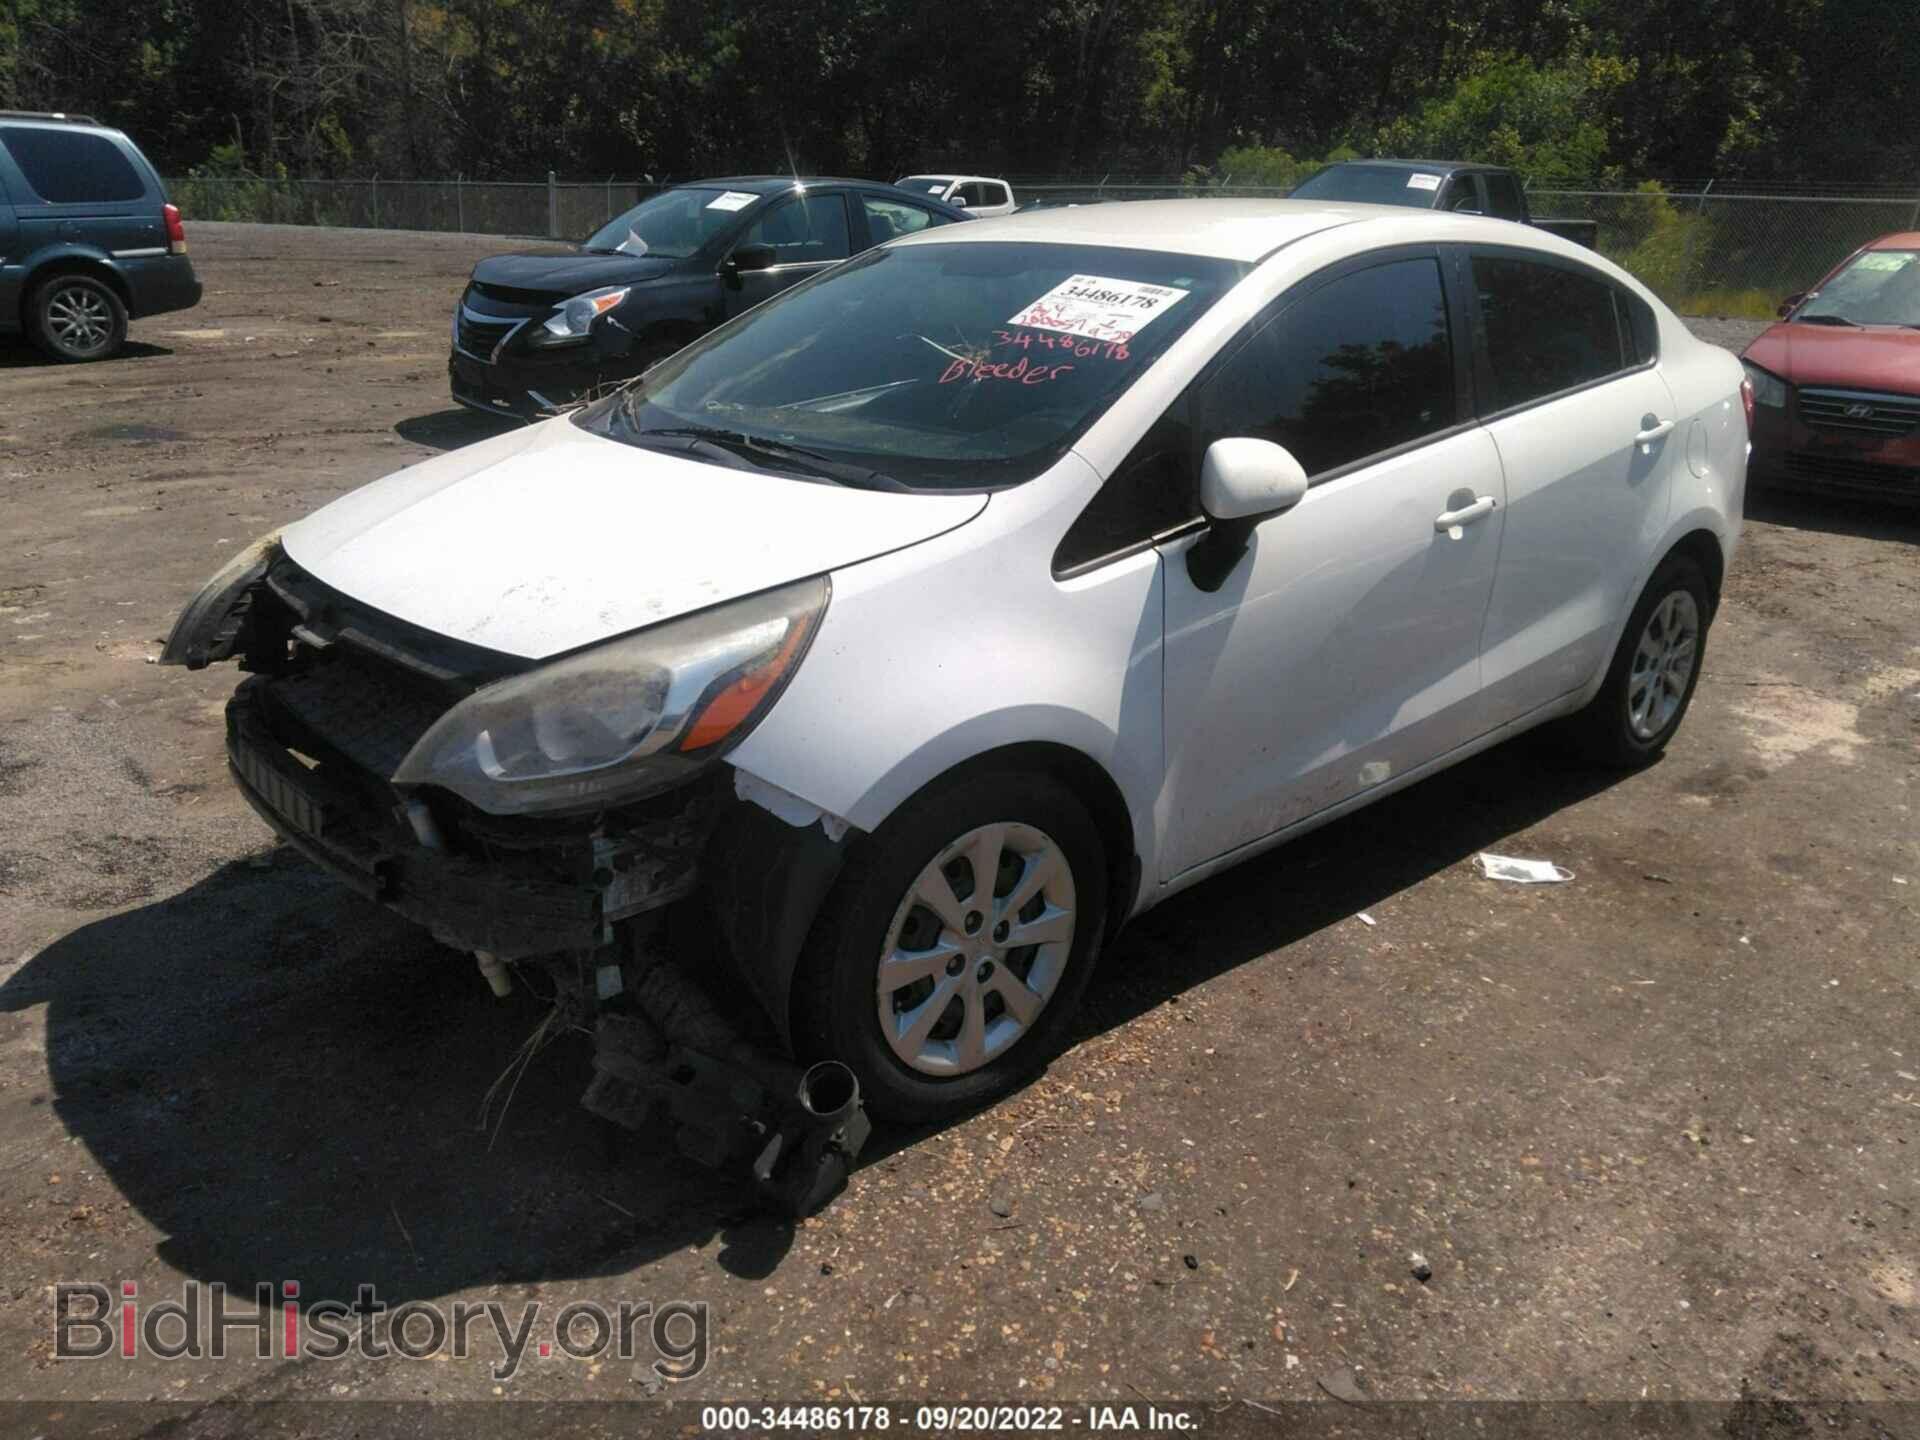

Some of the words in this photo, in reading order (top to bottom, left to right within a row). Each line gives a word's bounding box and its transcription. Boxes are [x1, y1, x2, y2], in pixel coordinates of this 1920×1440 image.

[1060, 285, 1160, 310] 34486178
[992, 330, 1130, 361] 34486178
[938, 356, 1074, 384] Bleeder
